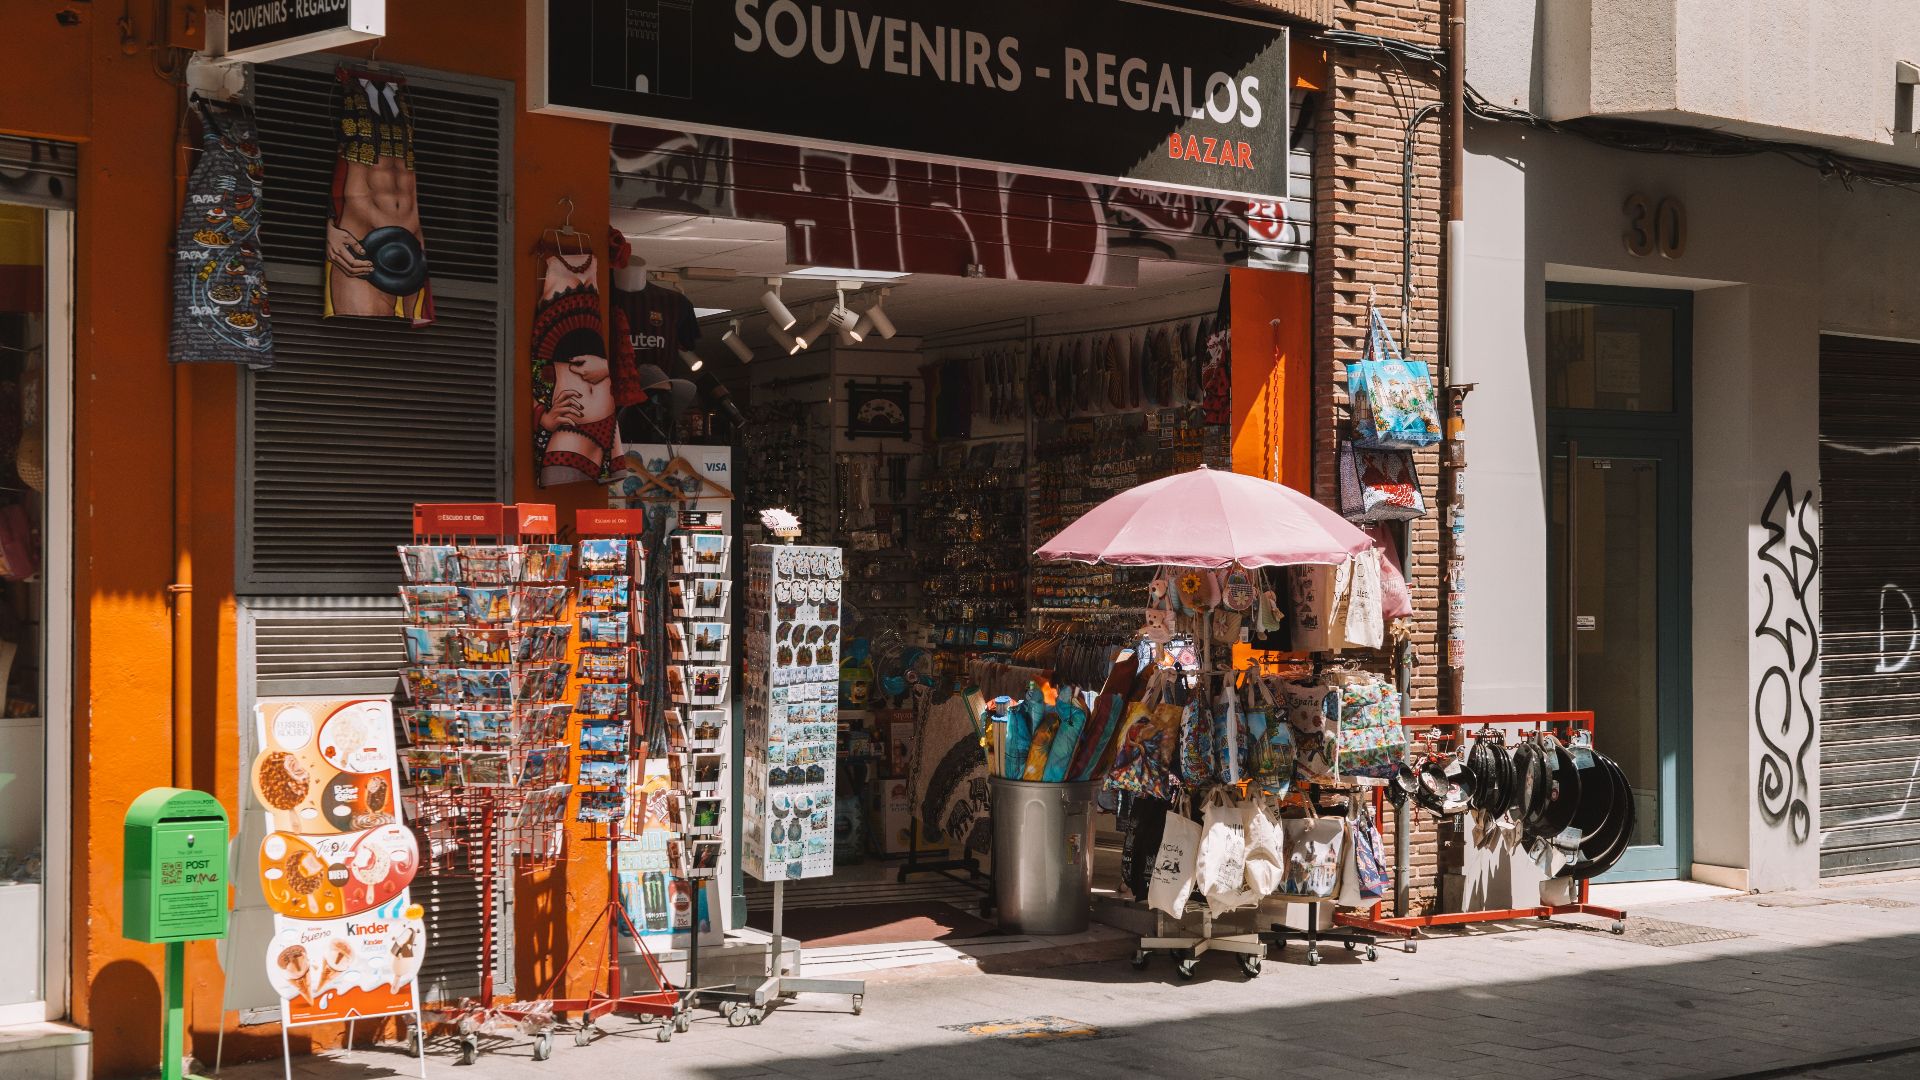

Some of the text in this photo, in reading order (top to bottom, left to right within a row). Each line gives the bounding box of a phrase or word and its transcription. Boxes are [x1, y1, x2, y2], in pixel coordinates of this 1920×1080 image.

[229, 1, 287, 34] SOUVENIRS
[733, 0, 1262, 129] SOUVENIRS - REGALOS
[1168, 132, 1254, 170] BAZAR
[192, 194, 222, 204] TAPAS
[1622, 192, 1687, 259] 30
[178, 250, 209, 260] TAPAS
[188, 306, 220, 316] TAPAS
[705, 462, 727, 472] VISA
[185, 860, 210, 870] POST
[185, 874, 196, 883] BY
[300, 928, 332, 944] bueno
